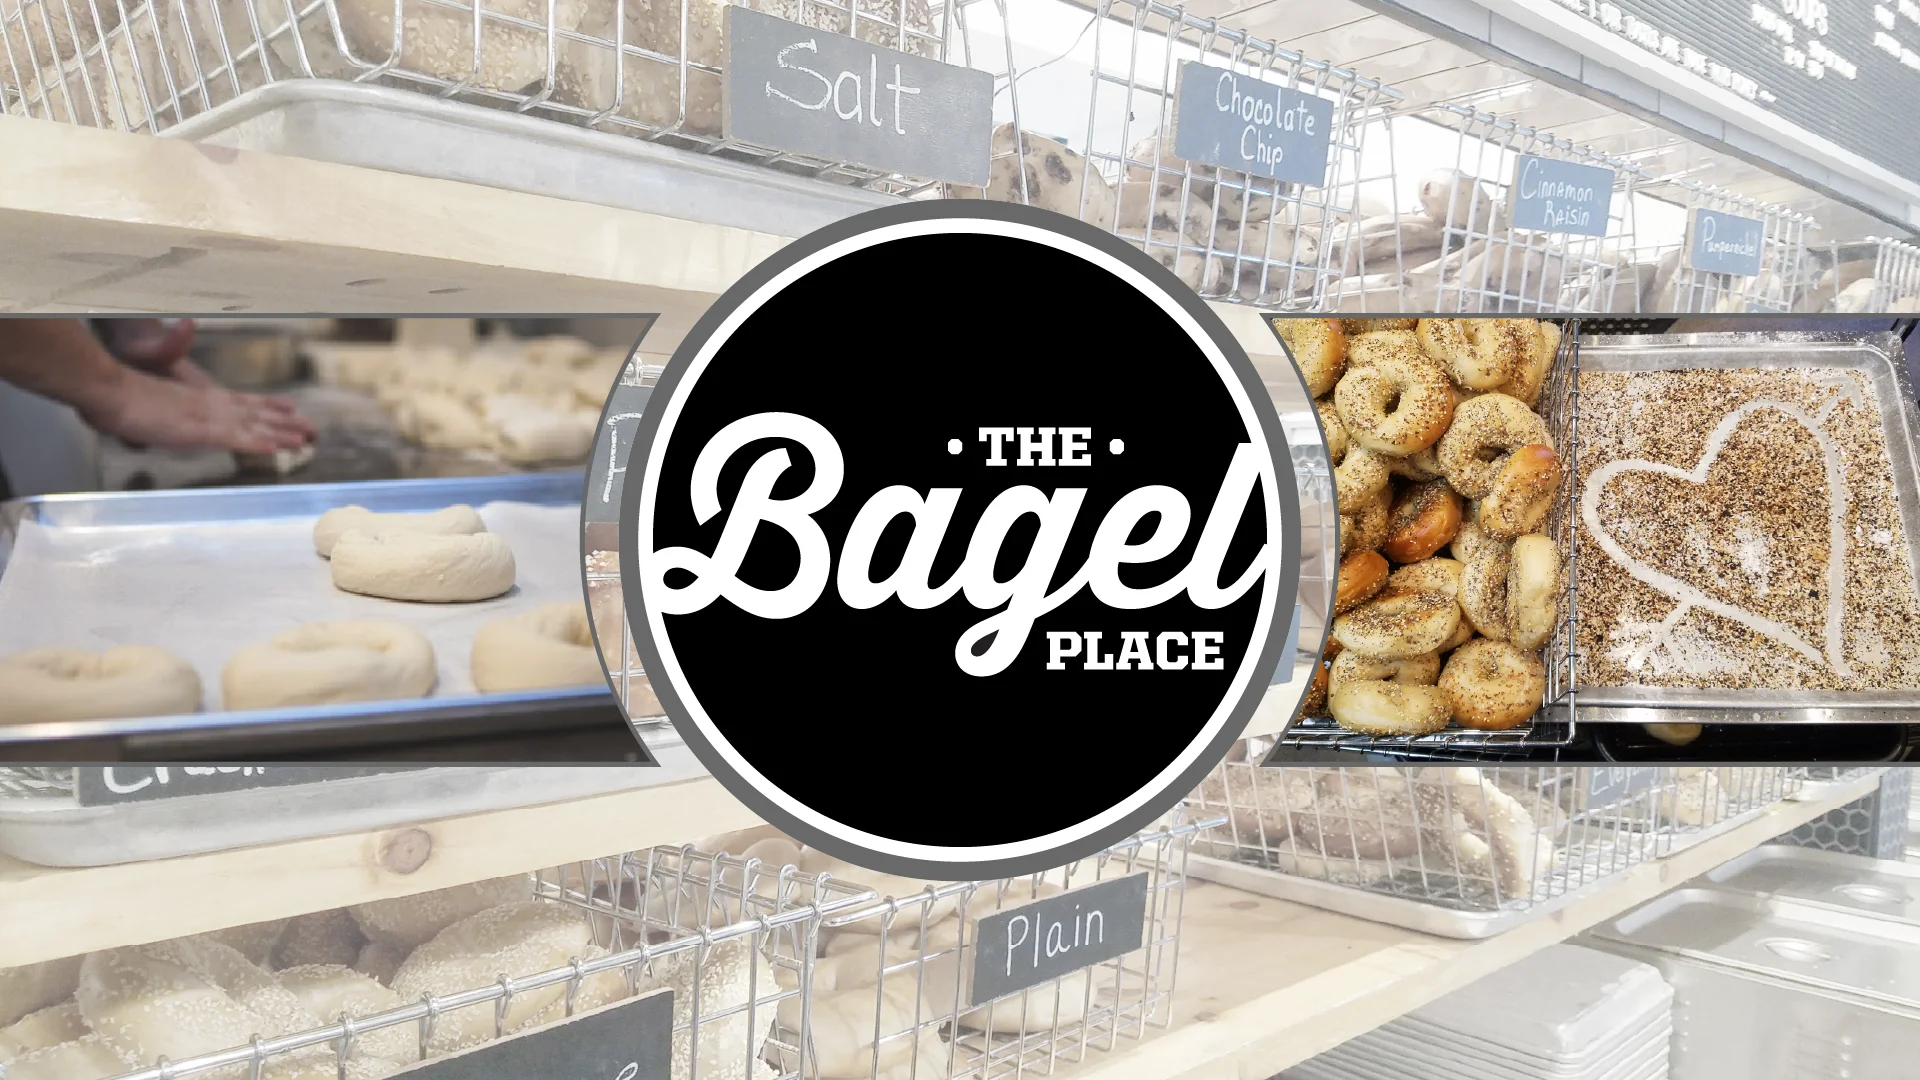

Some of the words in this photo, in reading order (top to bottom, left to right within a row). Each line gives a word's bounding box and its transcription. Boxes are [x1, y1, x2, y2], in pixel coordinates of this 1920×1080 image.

[765, 38, 921, 134] Salt
[1215, 71, 1315, 136] Chocolate
[1240, 125, 1283, 176] Chip
[1006, 904, 1104, 976] Plain
